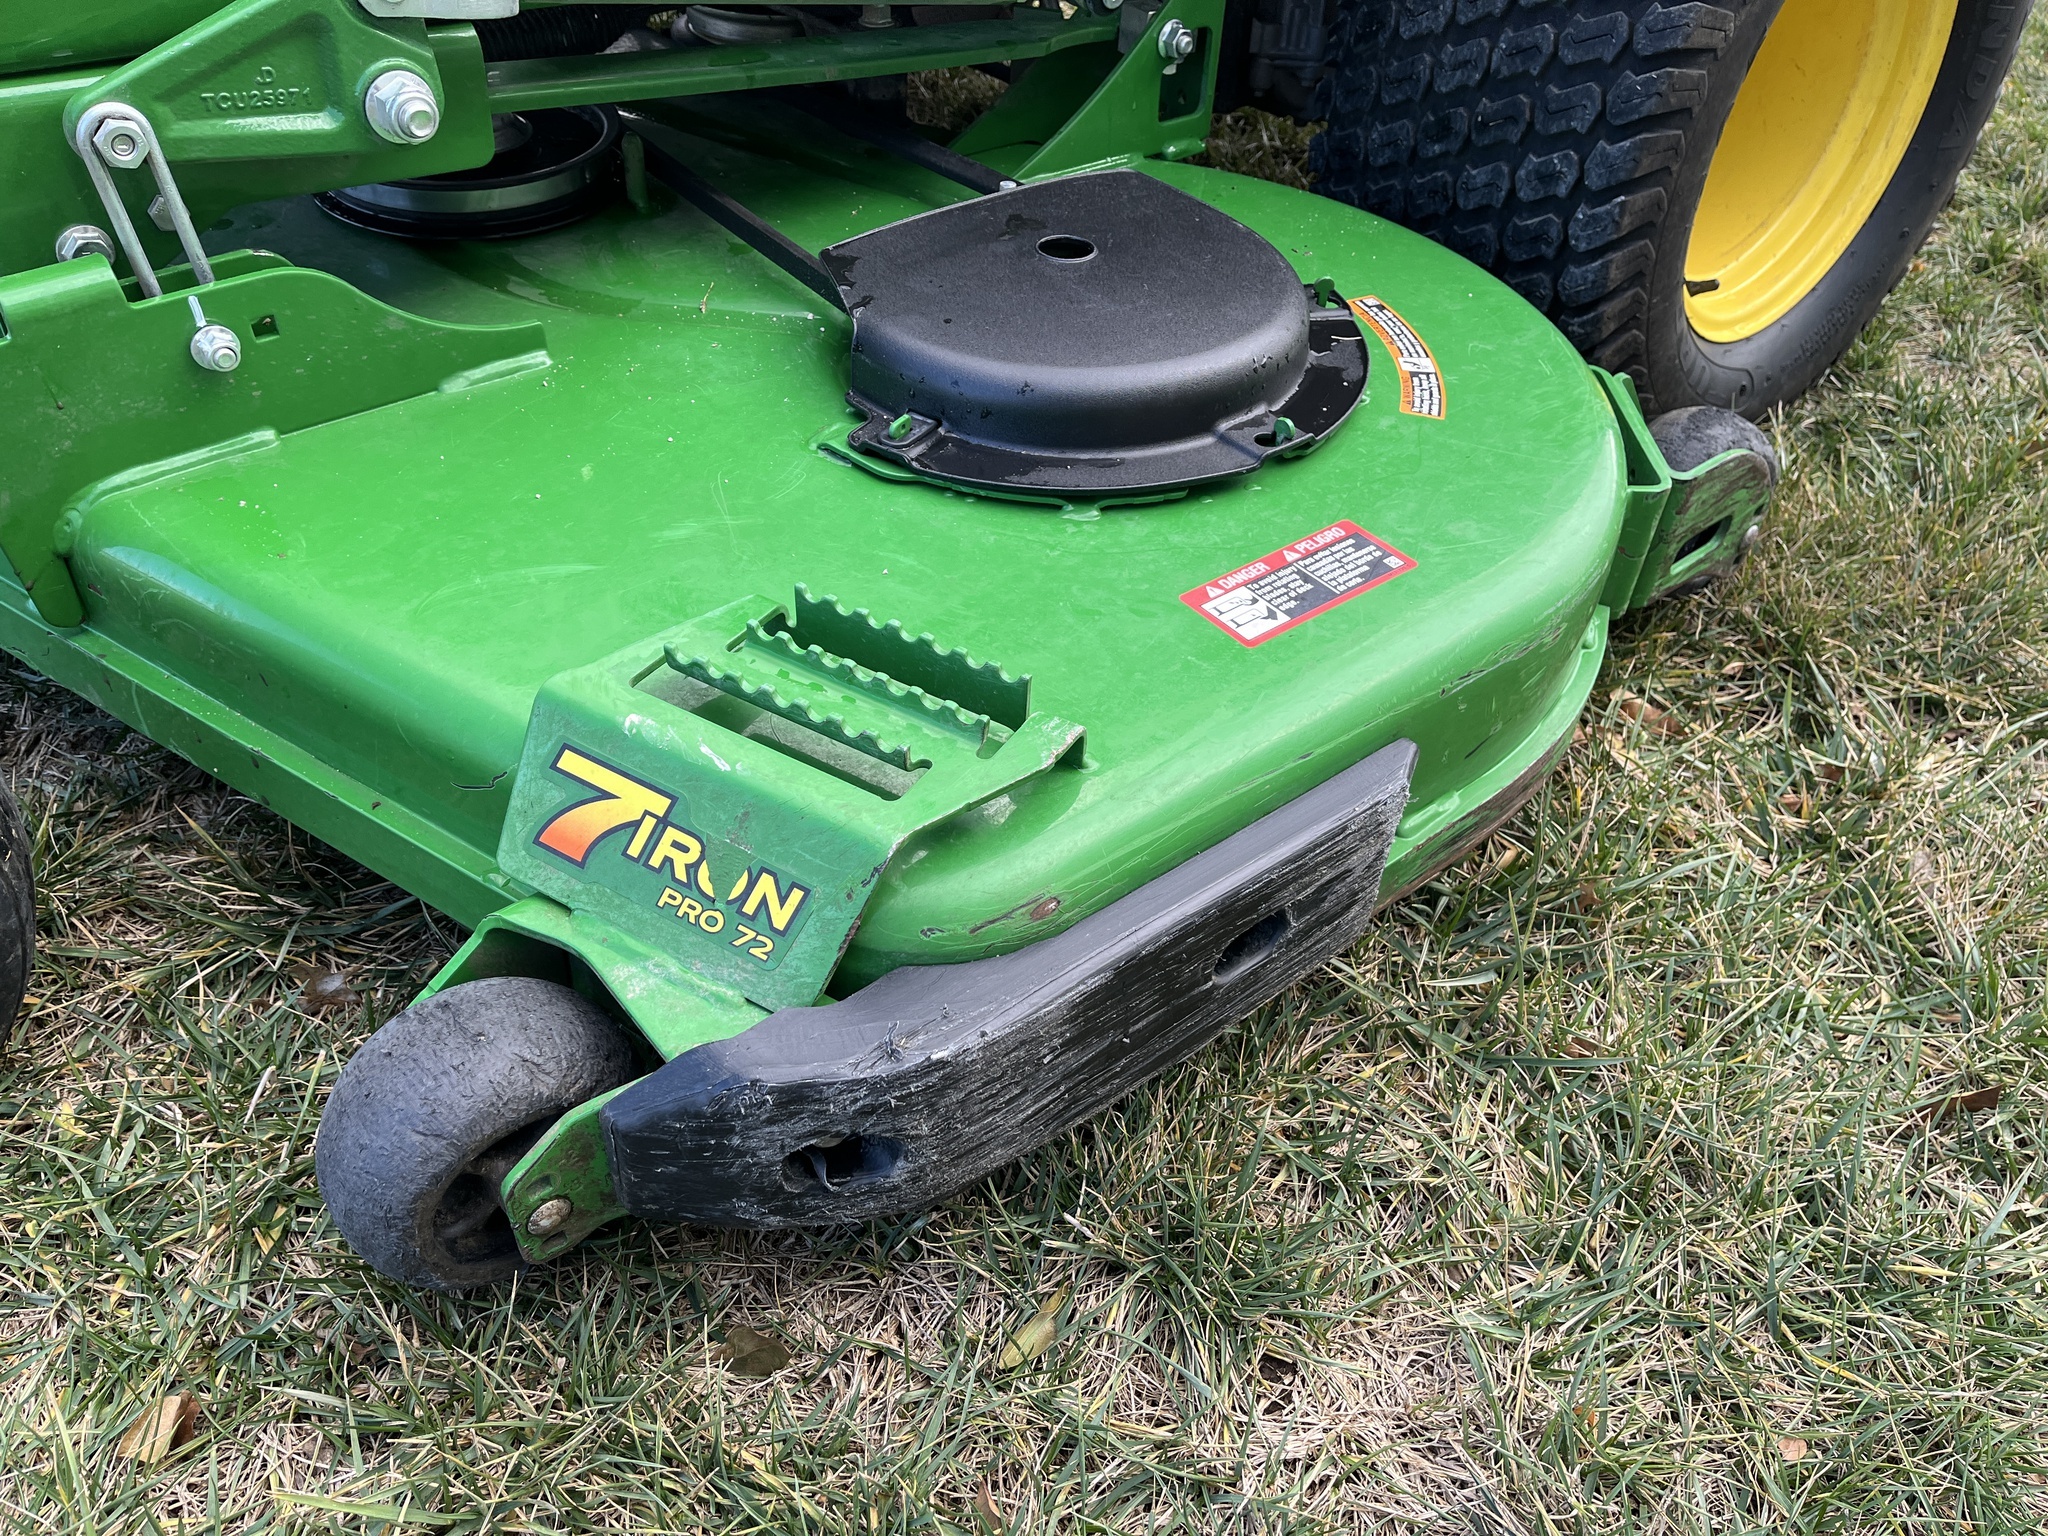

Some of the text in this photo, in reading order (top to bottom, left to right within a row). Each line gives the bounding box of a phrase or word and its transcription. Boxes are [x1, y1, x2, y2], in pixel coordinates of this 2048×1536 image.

[1937, 0, 2016, 149] NDA
[1293, 526, 1345, 553] PELIGRO
[1217, 561, 1270, 589] DANGER
[1254, 572, 1300, 595] from rotating
[1257, 573, 1278, 586] avoid
[1274, 565, 1297, 578] injury
[1261, 577, 1306, 600] blades, stay
[1270, 582, 1314, 605] clear of deck
[1278, 599, 1299, 611] edge.
[533, 743, 679, 869] 7
[656, 886, 775, 962] PRO 72
